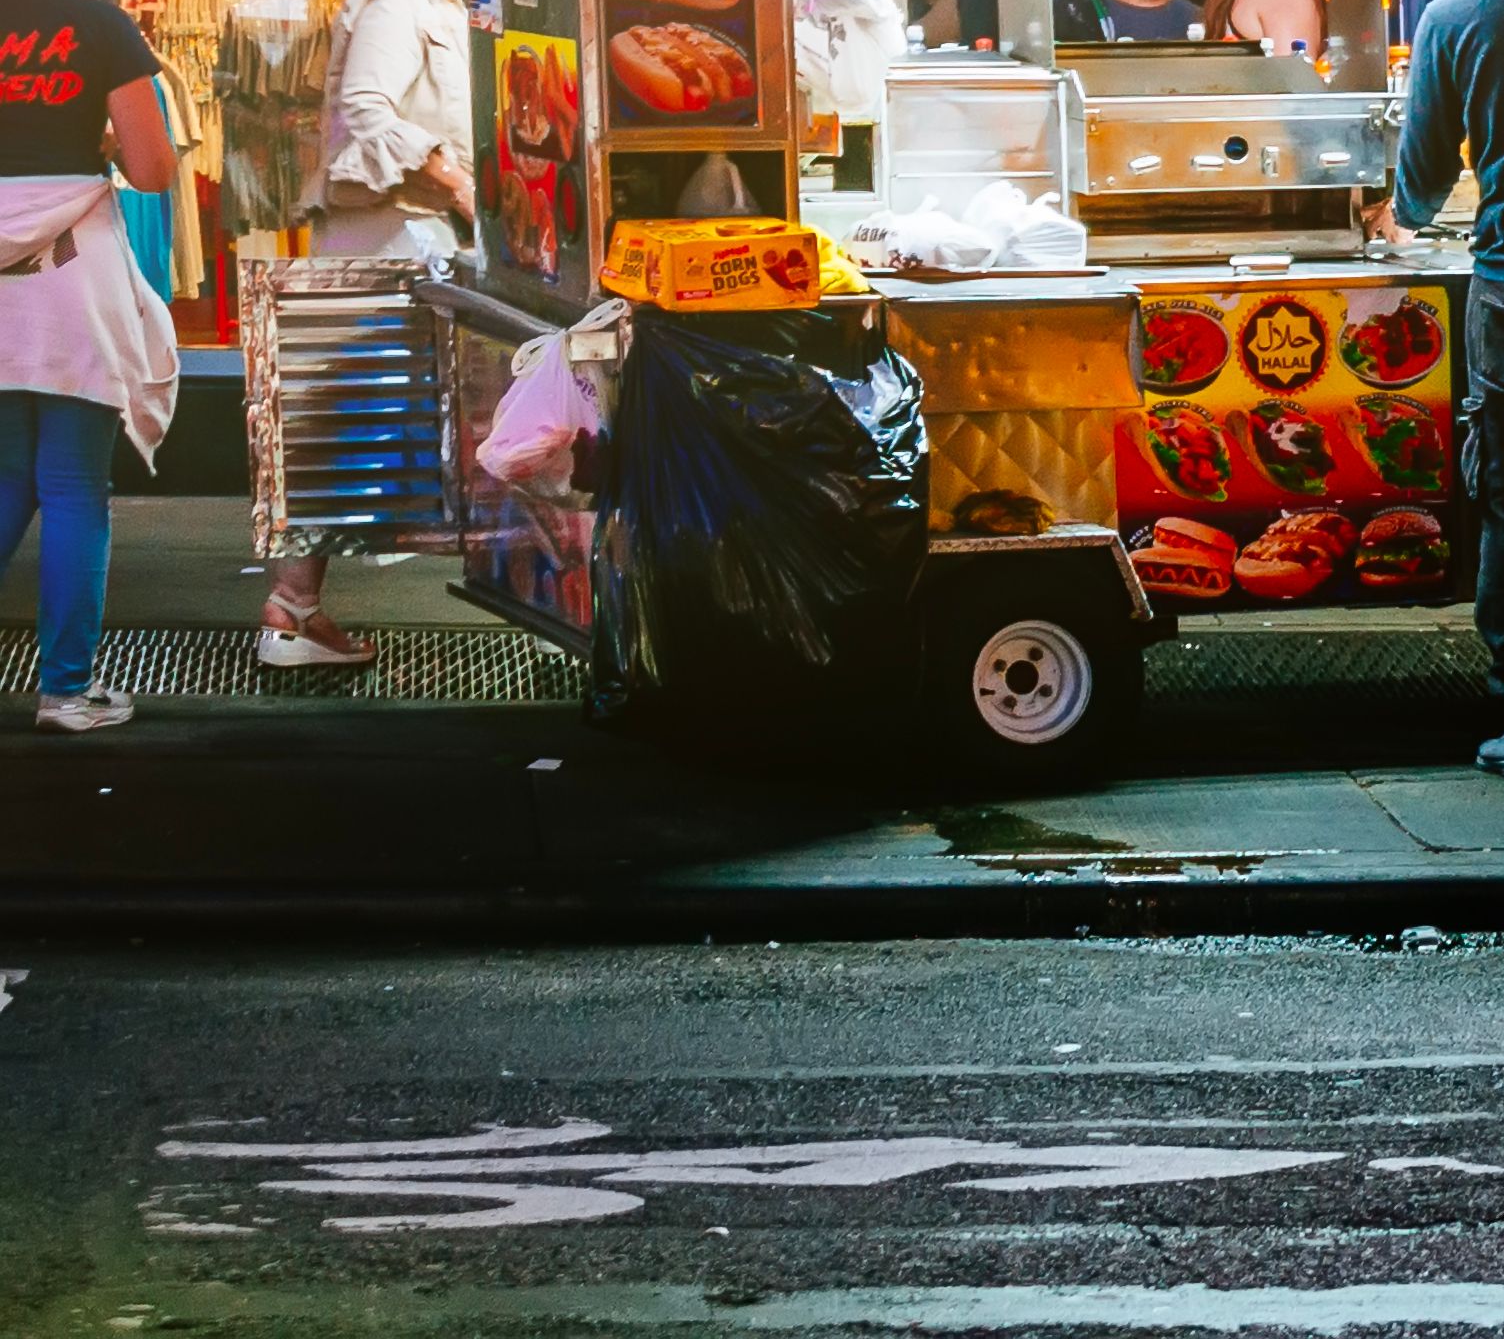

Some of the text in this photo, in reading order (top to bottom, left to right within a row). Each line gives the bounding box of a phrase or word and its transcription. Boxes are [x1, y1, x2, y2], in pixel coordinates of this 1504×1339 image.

[709, 254, 759, 276] CORN
[711, 270, 762, 292] DOGS
[1261, 356, 1310, 370] HALAL
